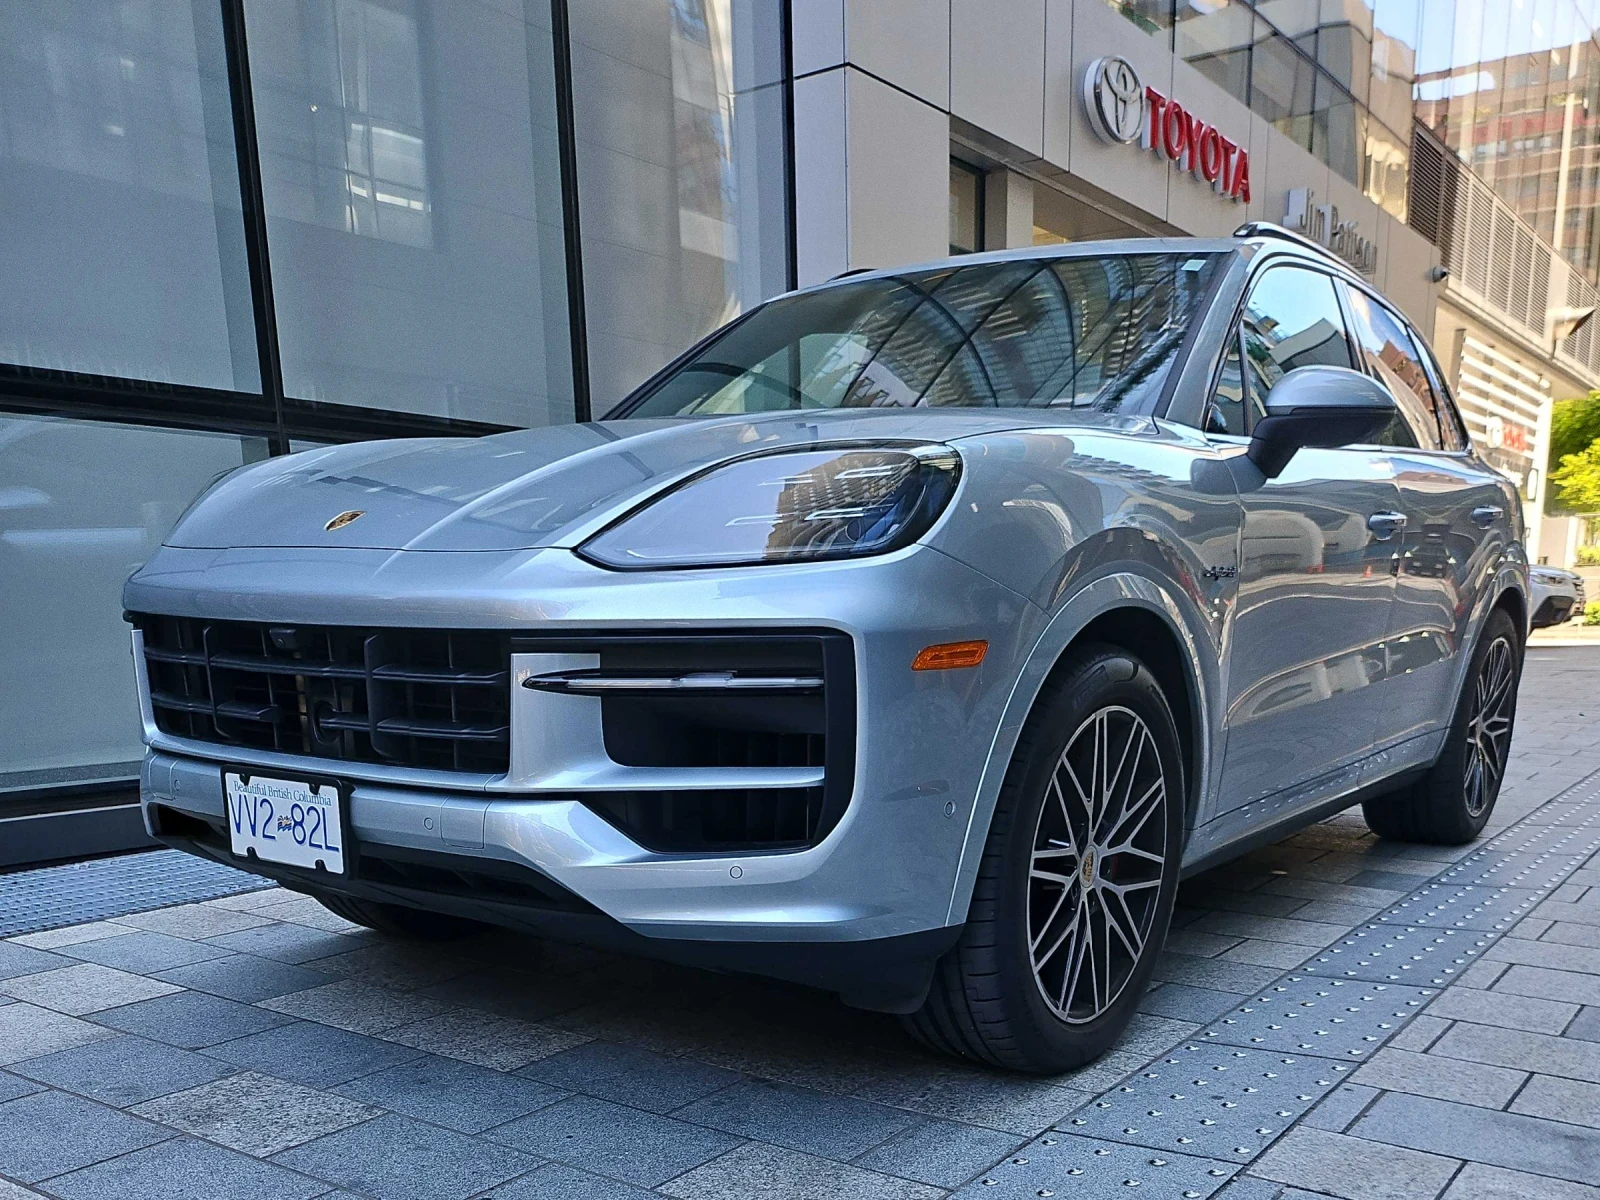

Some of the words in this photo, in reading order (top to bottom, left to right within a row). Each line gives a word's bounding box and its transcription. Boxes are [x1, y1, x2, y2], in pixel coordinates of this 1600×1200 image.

[1144, 86, 1250, 203] TOYOTA
[1284, 187, 1325, 243] Jim
[229, 792, 276, 840] VV2
[291, 803, 340, 852] 82L
[234, 781, 267, 796] Beautiful
[268, 786, 292, 801] British
[293, 790, 332, 806] Columbia
